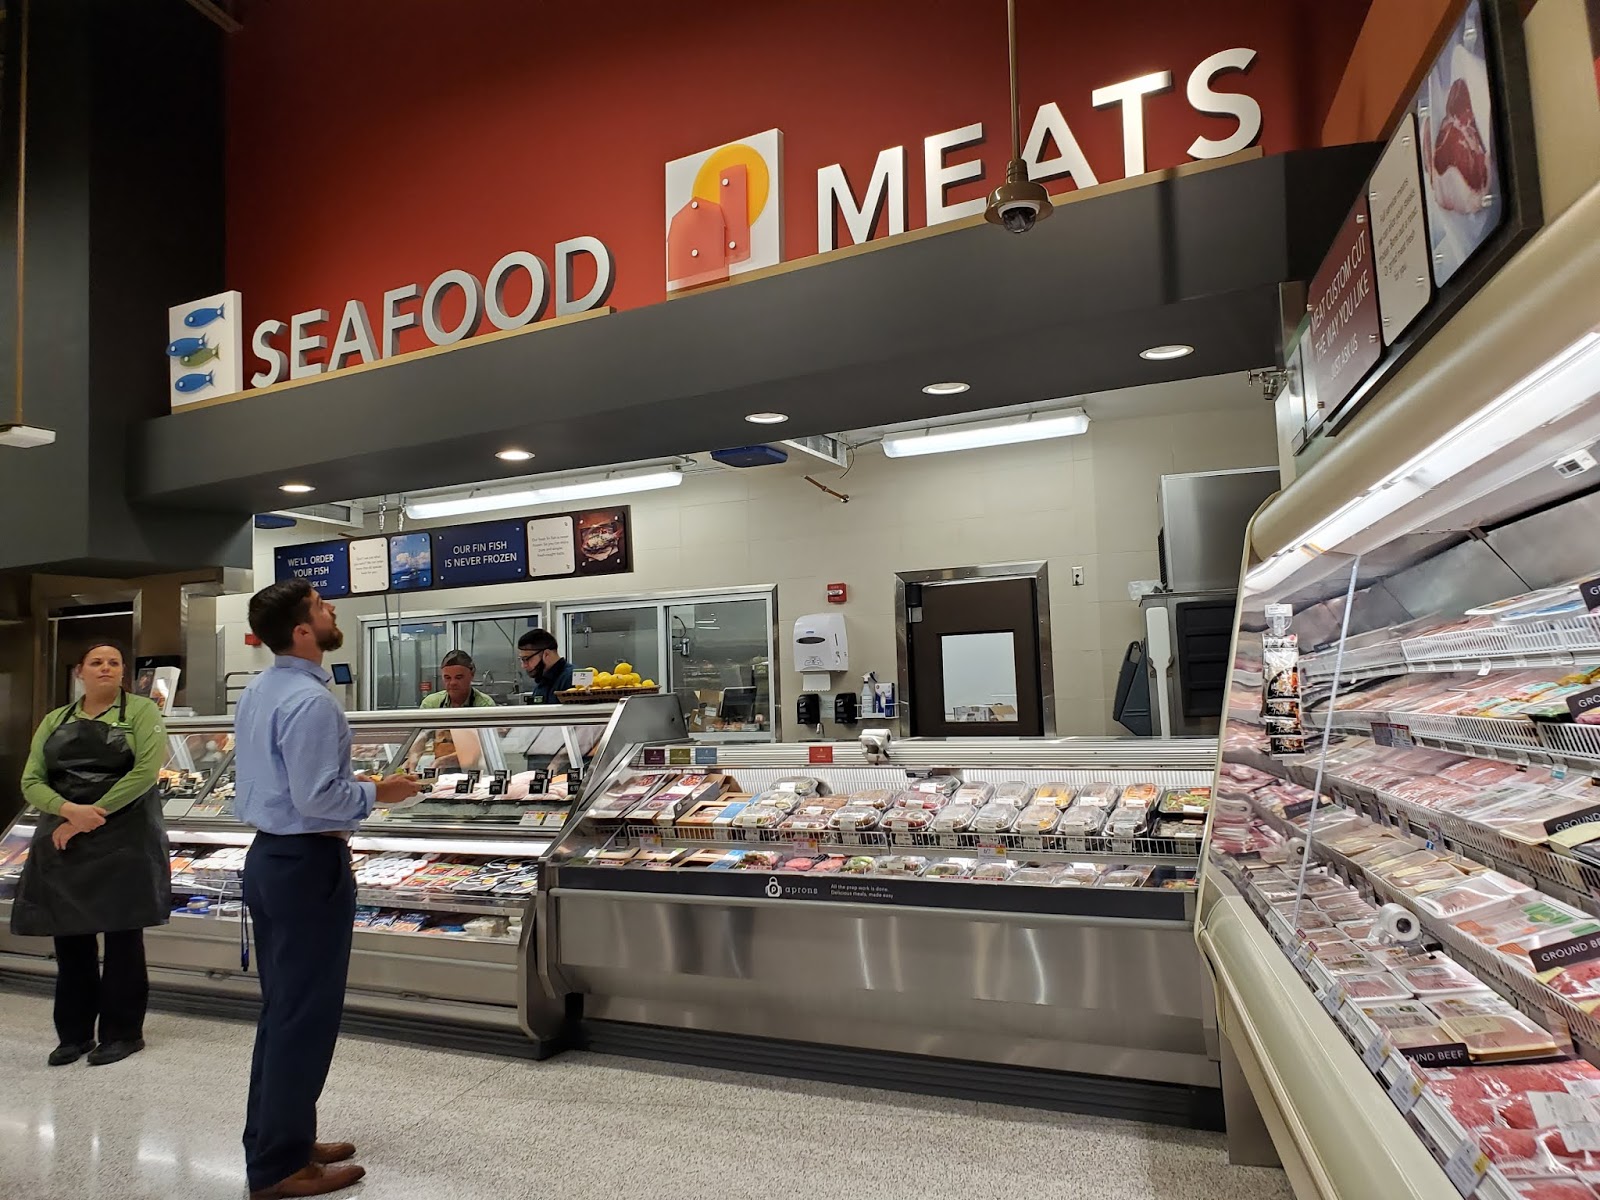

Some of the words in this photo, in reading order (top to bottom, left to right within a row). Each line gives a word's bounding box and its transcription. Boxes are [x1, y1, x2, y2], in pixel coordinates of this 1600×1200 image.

[817, 47, 1262, 254] MEATS
[1326, 255, 1352, 311] CUSTOM
[1352, 230, 1366, 269] CUT
[250, 236, 616, 389] SEAFOOD
[1315, 333, 1327, 363] THE
[1325, 312, 1339, 348] WAY
[1339, 292, 1354, 328] YOU
[1354, 269, 1369, 309] LIKE
[453, 544, 471, 555] OUR
[472, 543, 487, 553] FIN
[488, 540, 507, 551] FISH
[287, 557, 309, 567] WE'LL
[310, 553, 335, 565] ORDER
[444, 558, 453, 568] IS
[453, 556, 481, 567] NEVER
[483, 552, 518, 564] FROZEN
[293, 567, 313, 577] YOUR
[313, 566, 330, 576] FISH
[320, 579, 328, 587] US
[1578, 694, 1600, 708] GRO
[1555, 812, 1600, 832] GROUND
[785, 886, 819, 895] aprons
[1541, 942, 1588, 962] GROUND
[1590, 937, 1600, 949] BE
[1437, 1050, 1464, 1061] BEEF
